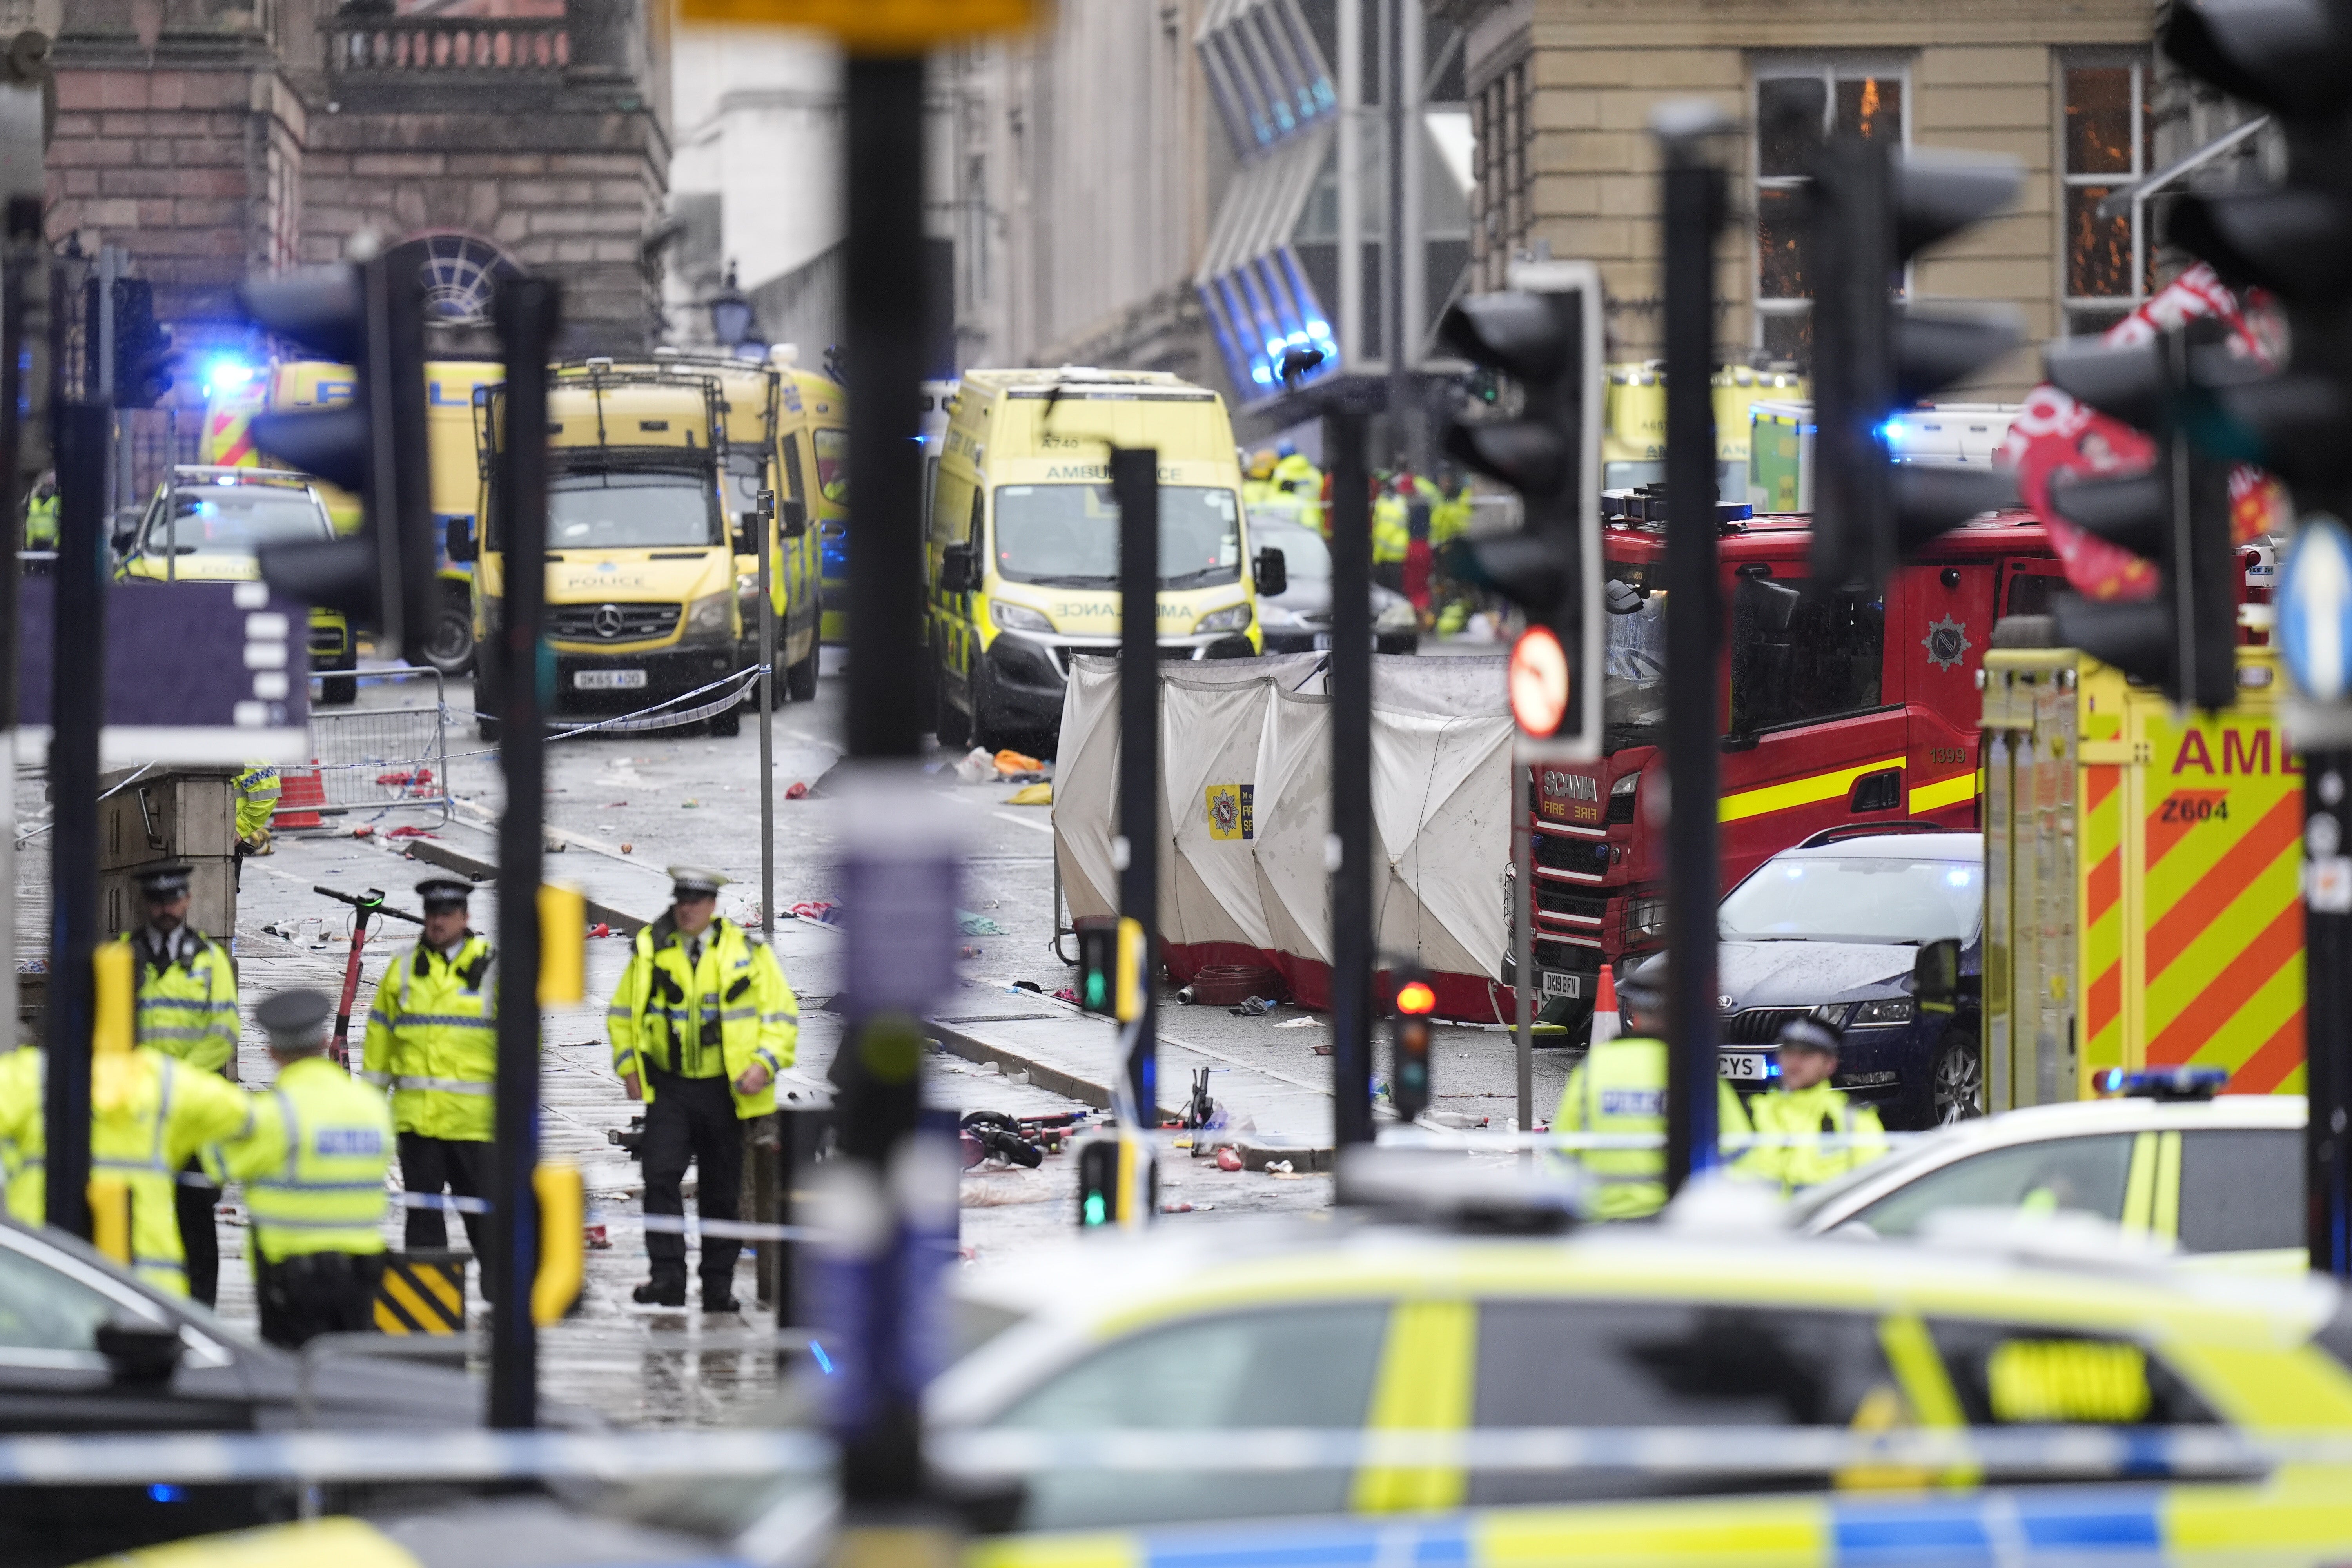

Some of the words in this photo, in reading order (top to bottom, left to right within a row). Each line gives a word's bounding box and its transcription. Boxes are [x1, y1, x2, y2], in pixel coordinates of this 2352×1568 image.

[1042, 436, 1079, 449] A740
[1047, 465, 1183, 481] AMBUCE
[569, 577, 645, 588] POLICE
[1930, 747, 1965, 763] 1399
[1544, 770, 1597, 802] SCANIA
[1544, 801, 1565, 816] FIRE
[2161, 798, 2228, 822] Z604
[1547, 974, 1561, 992] DK19
